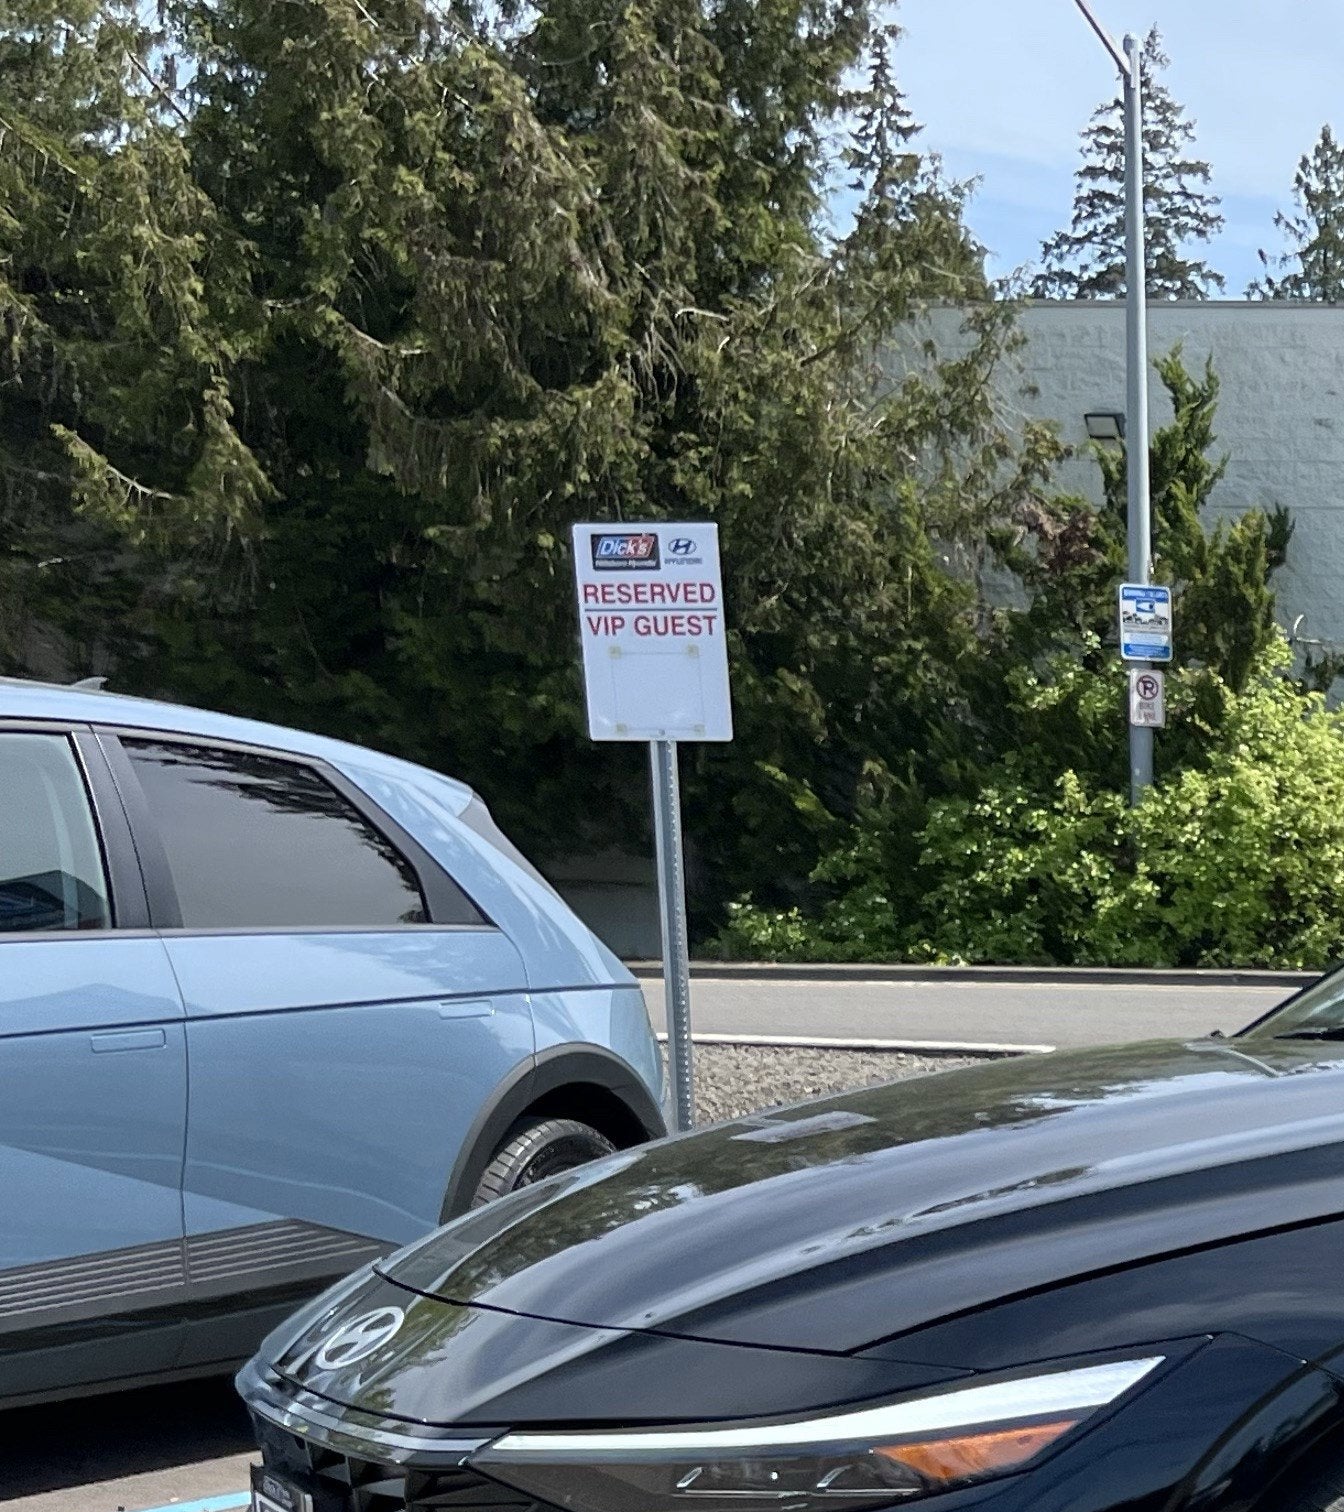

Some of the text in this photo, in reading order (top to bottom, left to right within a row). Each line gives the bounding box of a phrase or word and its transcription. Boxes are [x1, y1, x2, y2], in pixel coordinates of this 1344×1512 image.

[583, 582, 716, 604] RESERVED
[586, 615, 718, 637] VIP GUEST
